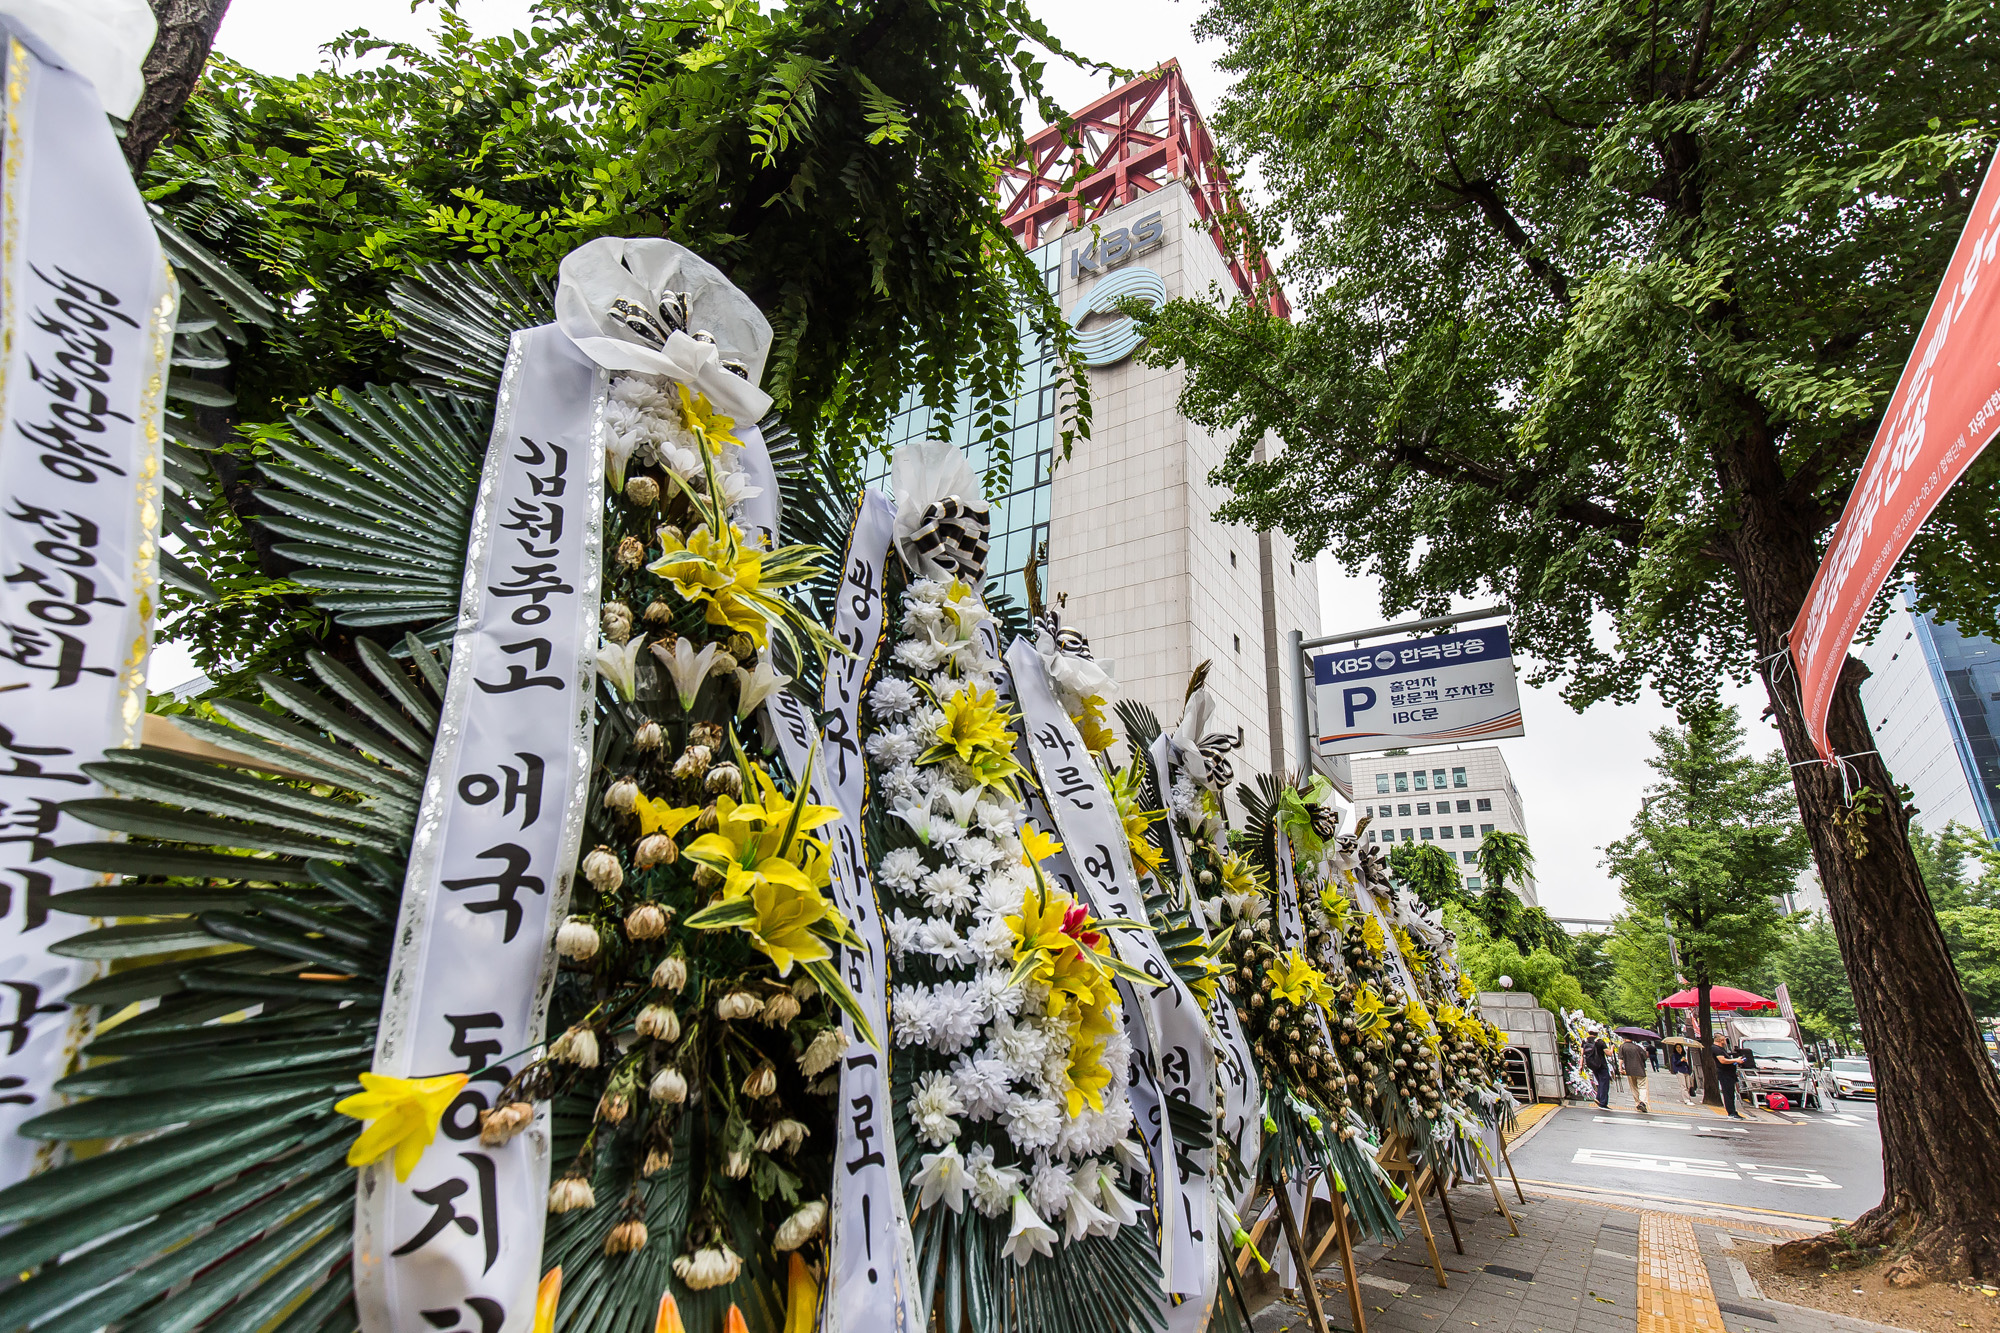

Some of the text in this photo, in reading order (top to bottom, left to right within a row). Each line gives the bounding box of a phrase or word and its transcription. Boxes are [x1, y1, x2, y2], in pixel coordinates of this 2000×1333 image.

[1071, 210, 1164, 279] KBS
[14, 260, 142, 484] 공정방송
[1884, 375, 1933, 507] 찬성
[1939, 432, 1967, 475] 협력단체
[0, 494, 127, 690] 정상화
[473, 435, 574, 695] 김천중고
[825, 558, 879, 787] 광진구
[1331, 638, 1485, 676] KBS 한국방송
[1389, 676, 1437, 693] 출연자
[1342, 686, 1377, 728] P
[1390, 682, 1495, 706] 방문객 주차장
[1392, 707, 1439, 724] IBC문
[1034, 722, 1095, 810] 바른
[1398, 774, 1465, 788] 스카우트
[440, 751, 546, 944] 애국
